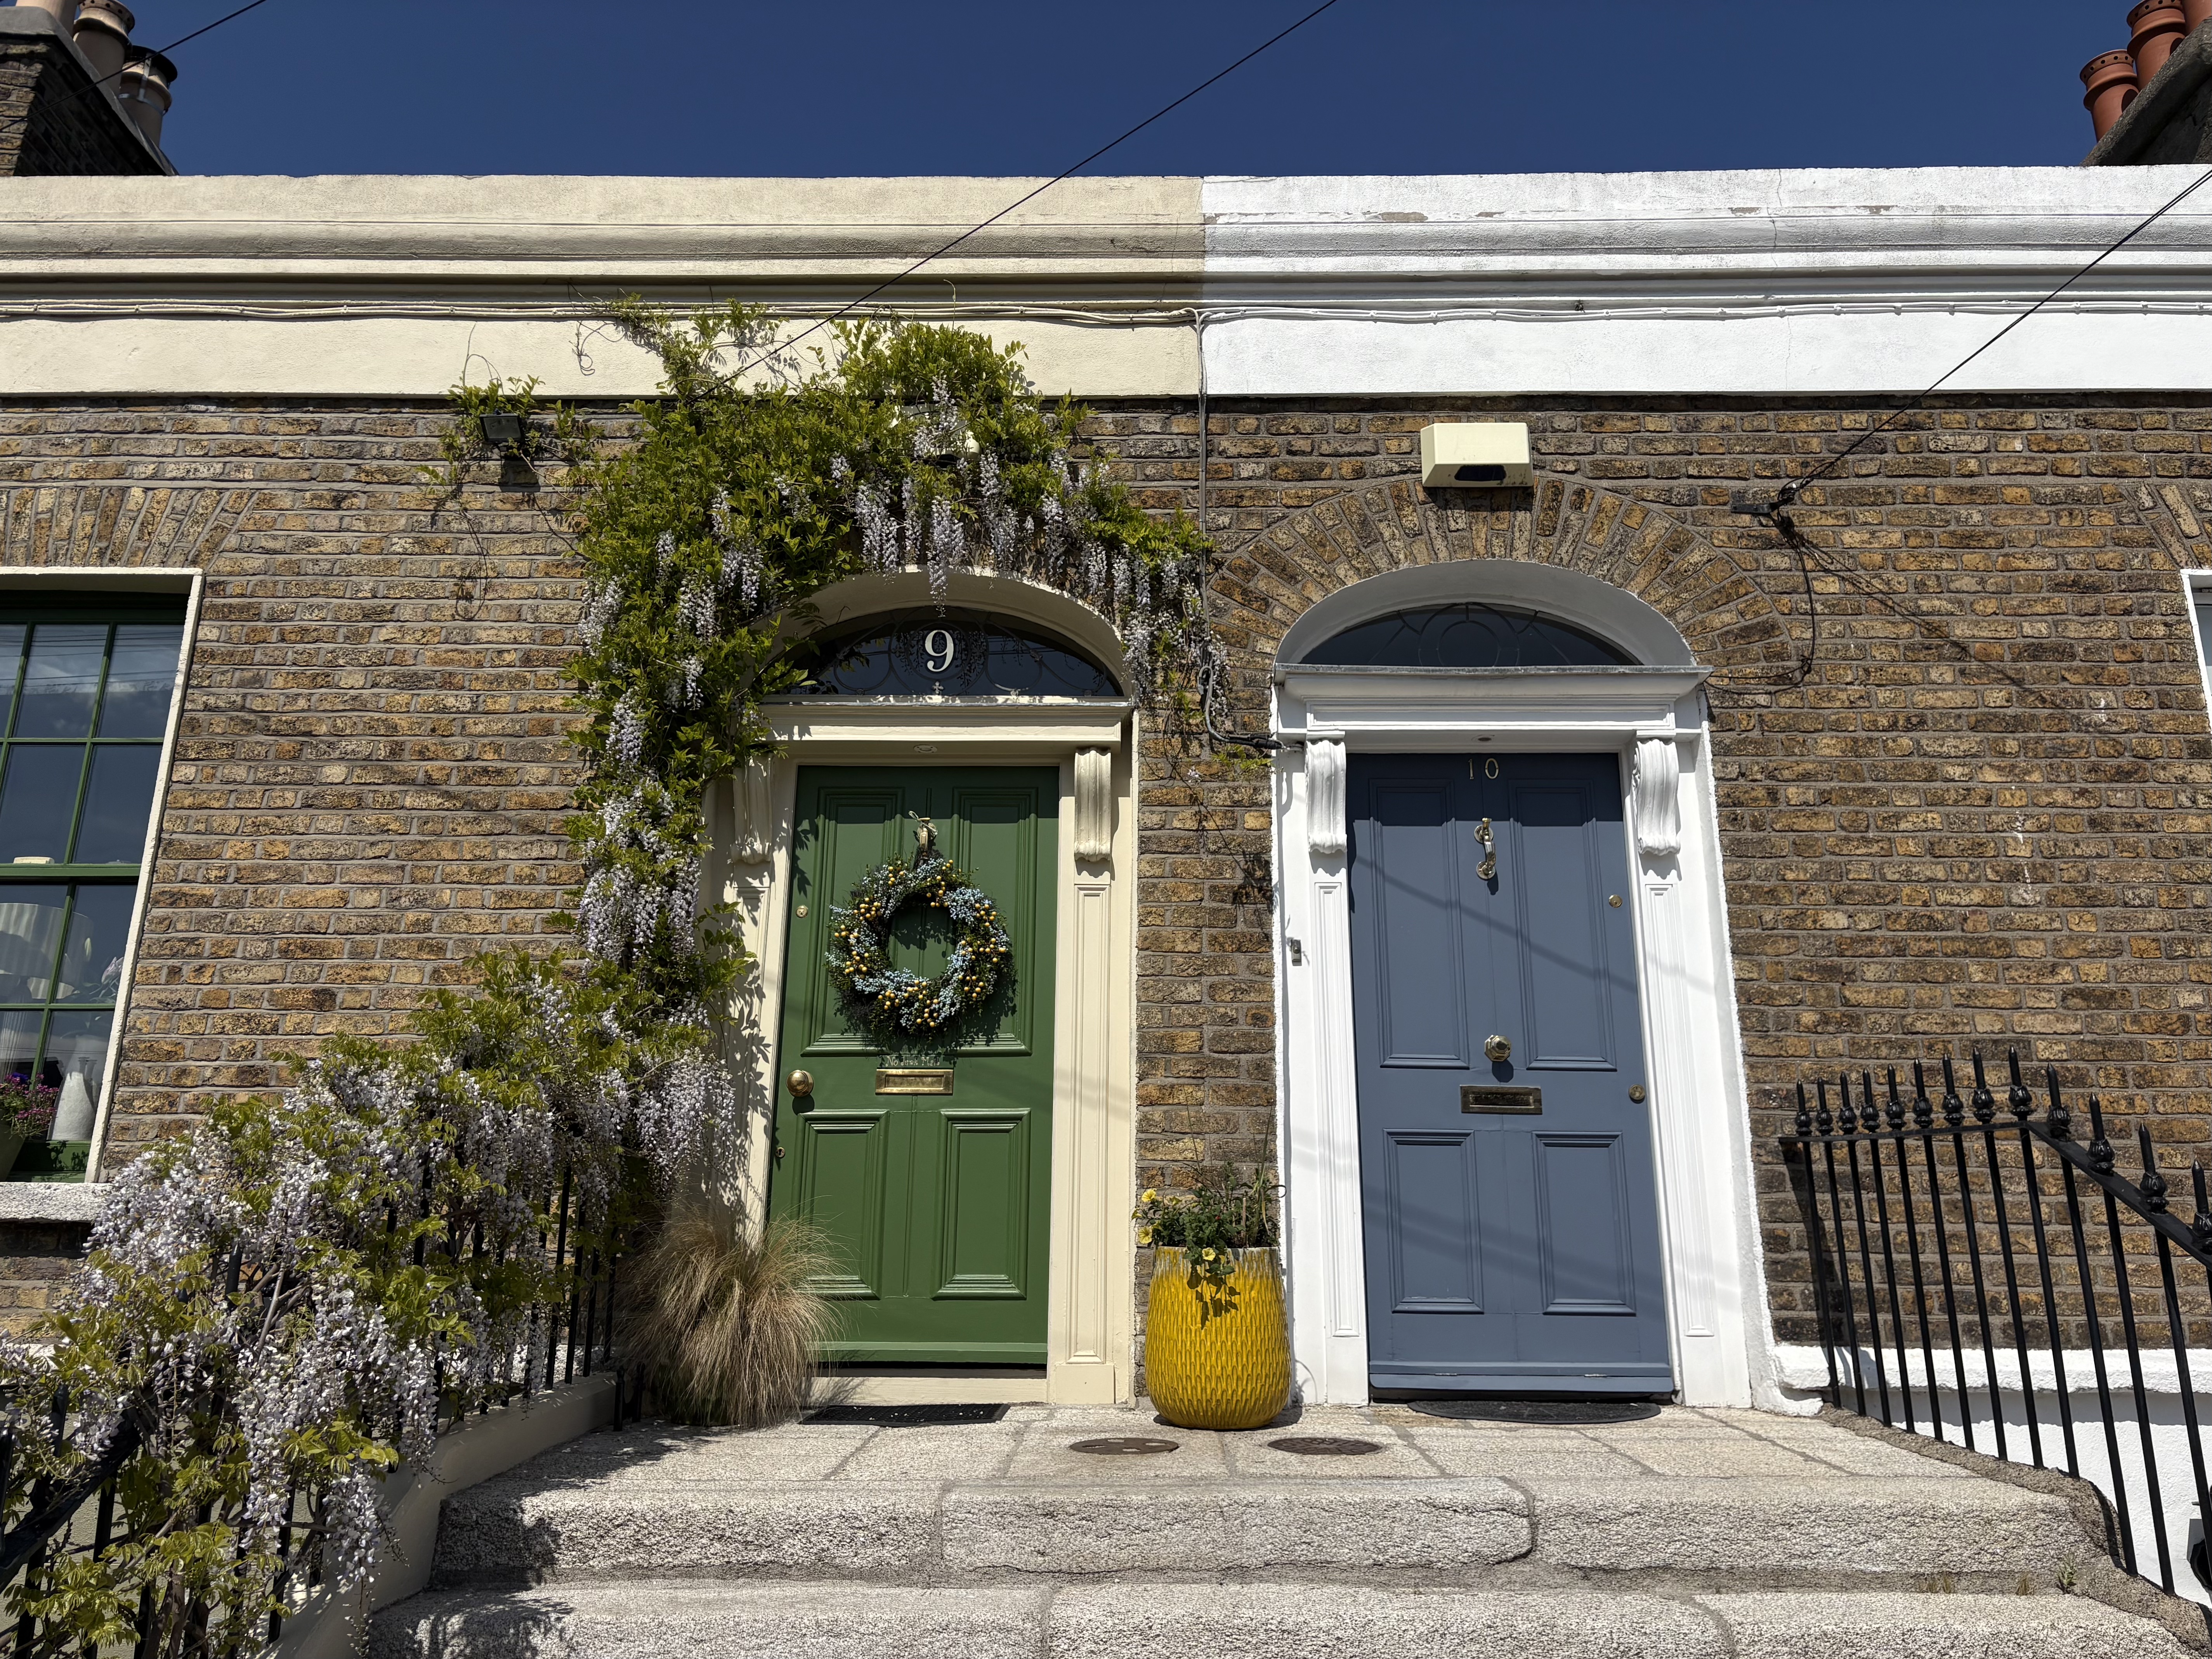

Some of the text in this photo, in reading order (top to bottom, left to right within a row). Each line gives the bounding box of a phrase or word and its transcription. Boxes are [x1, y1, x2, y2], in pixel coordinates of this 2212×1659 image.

[925, 630, 954, 672] 9
[1468, 758, 1499, 779] 10
[885, 1056, 940, 1067] No Junk Mail
